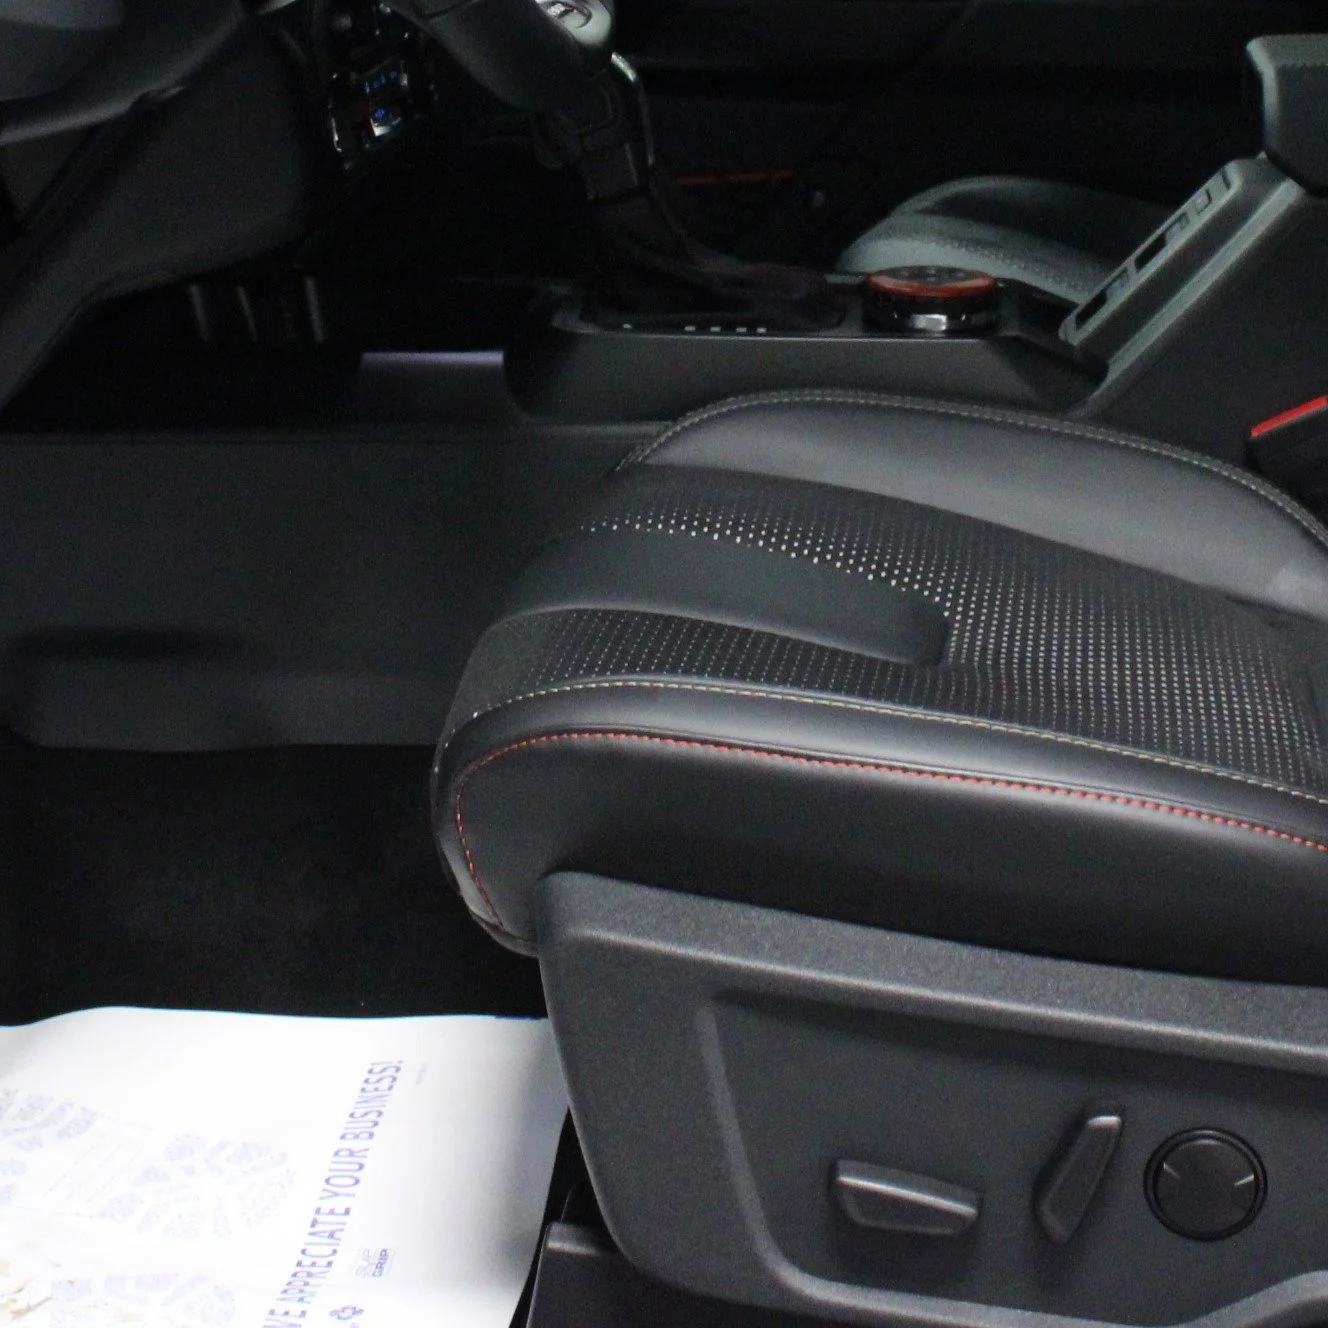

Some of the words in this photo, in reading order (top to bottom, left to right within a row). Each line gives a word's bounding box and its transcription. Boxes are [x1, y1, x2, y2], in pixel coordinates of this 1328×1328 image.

[339, 1060, 404, 1141] BUSINESS!
[319, 1147, 370, 1200] YOUR
[276, 1206, 352, 1305] APPRECIATE
